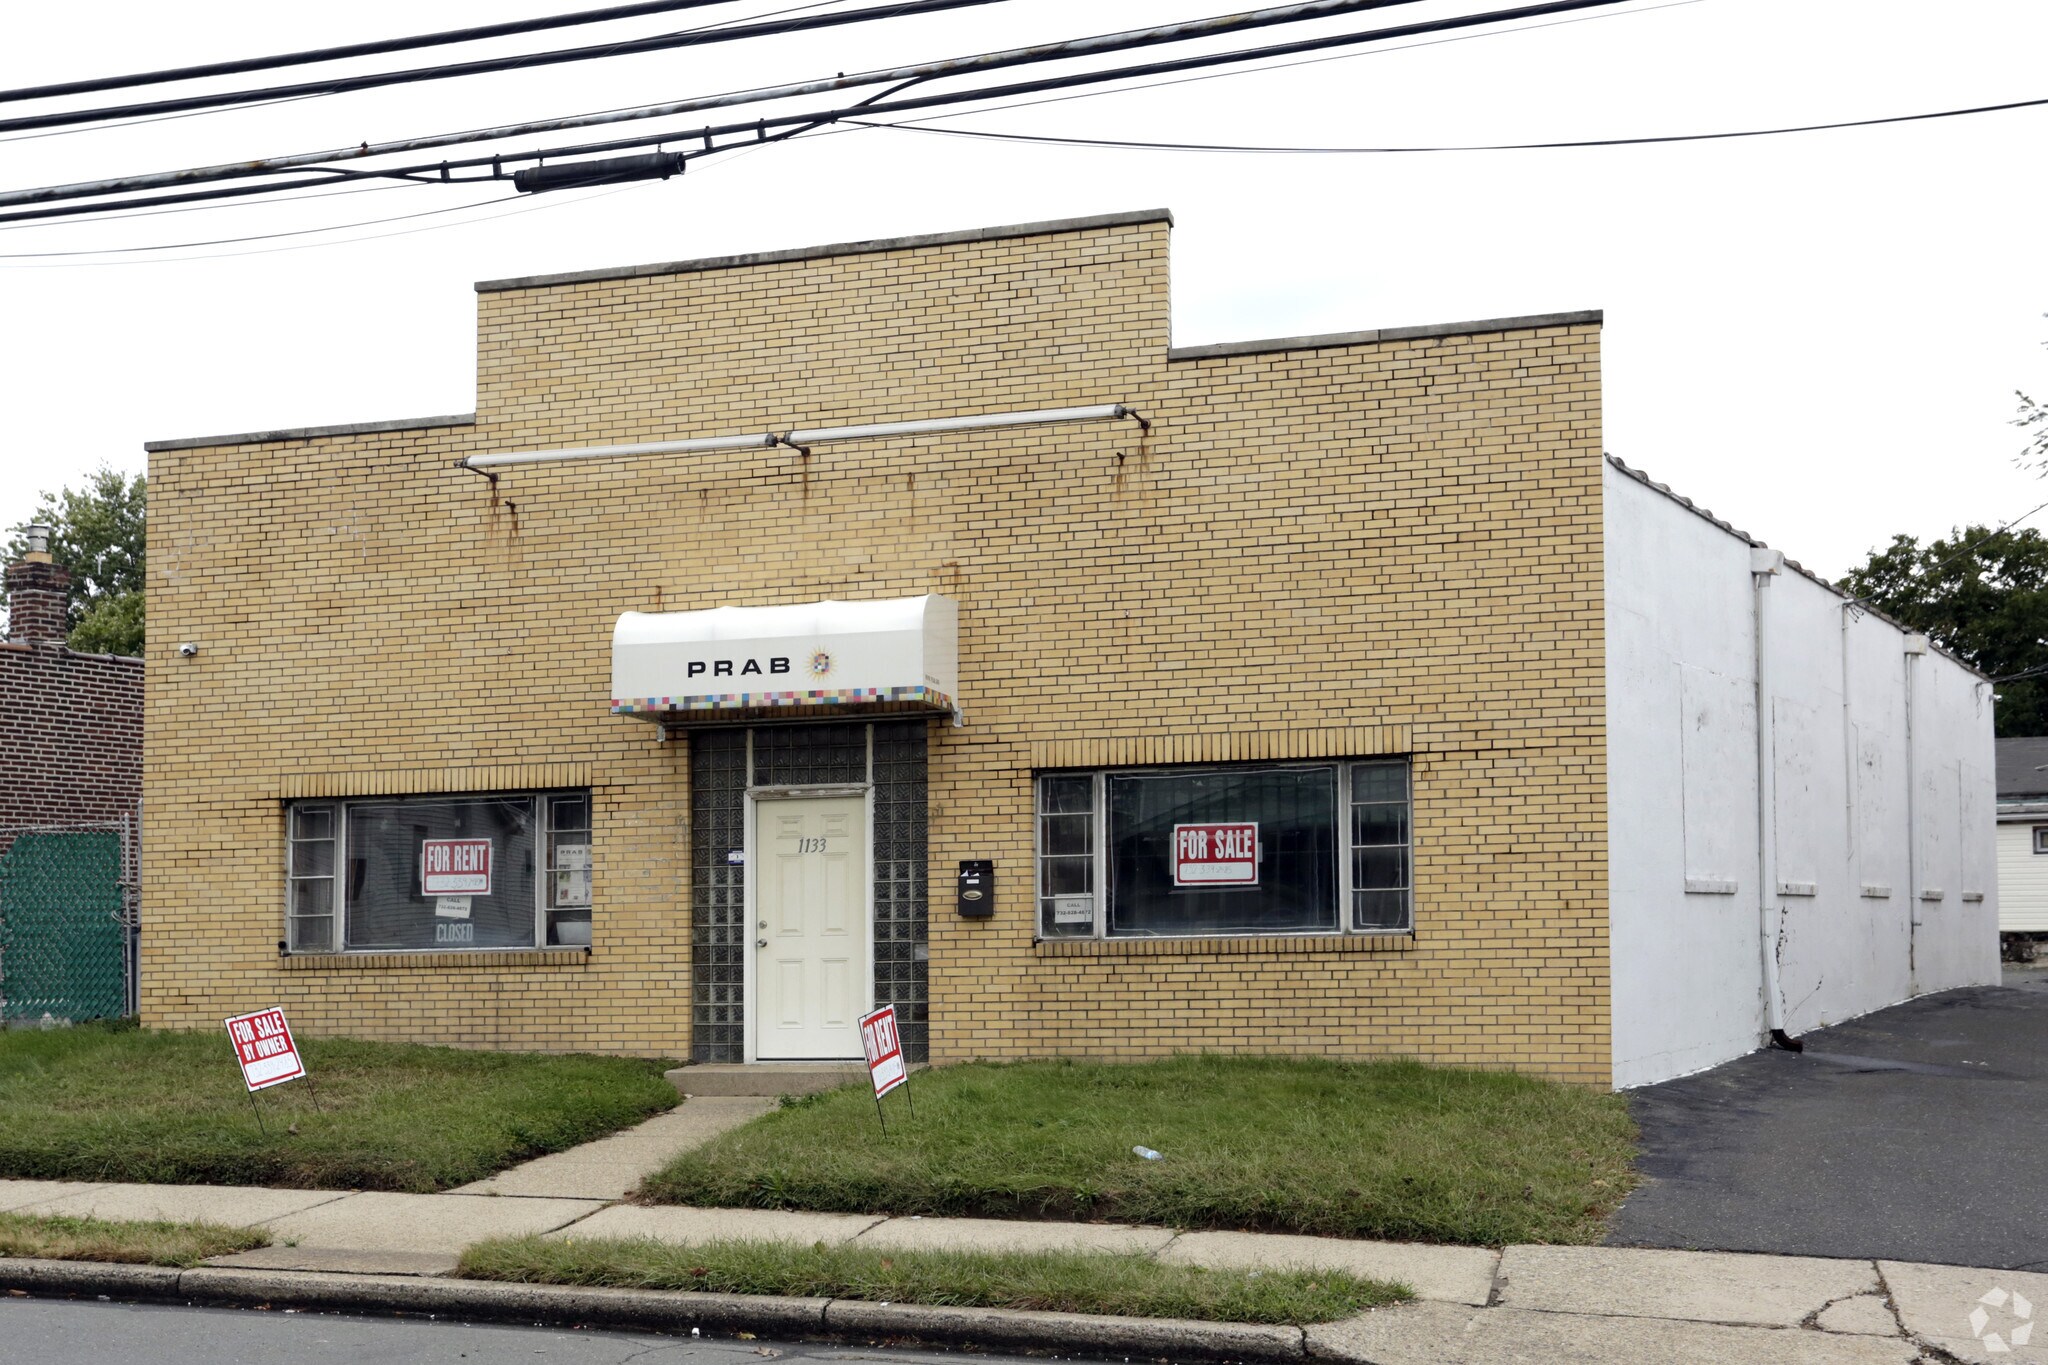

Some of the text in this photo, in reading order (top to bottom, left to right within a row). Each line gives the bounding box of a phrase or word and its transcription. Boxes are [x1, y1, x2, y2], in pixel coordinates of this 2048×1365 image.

[687, 657, 791, 678] PRAB
[798, 838, 827, 853] 1133
[1180, 829, 1252, 860] FOR SALE
[427, 845, 486, 872] FOR RENT
[437, 923, 473, 942] CLOSED
[232, 1013, 284, 1044] FOR SALE
[864, 1014, 896, 1064] FOR RENT
[242, 1035, 288, 1061] BY OWNER
